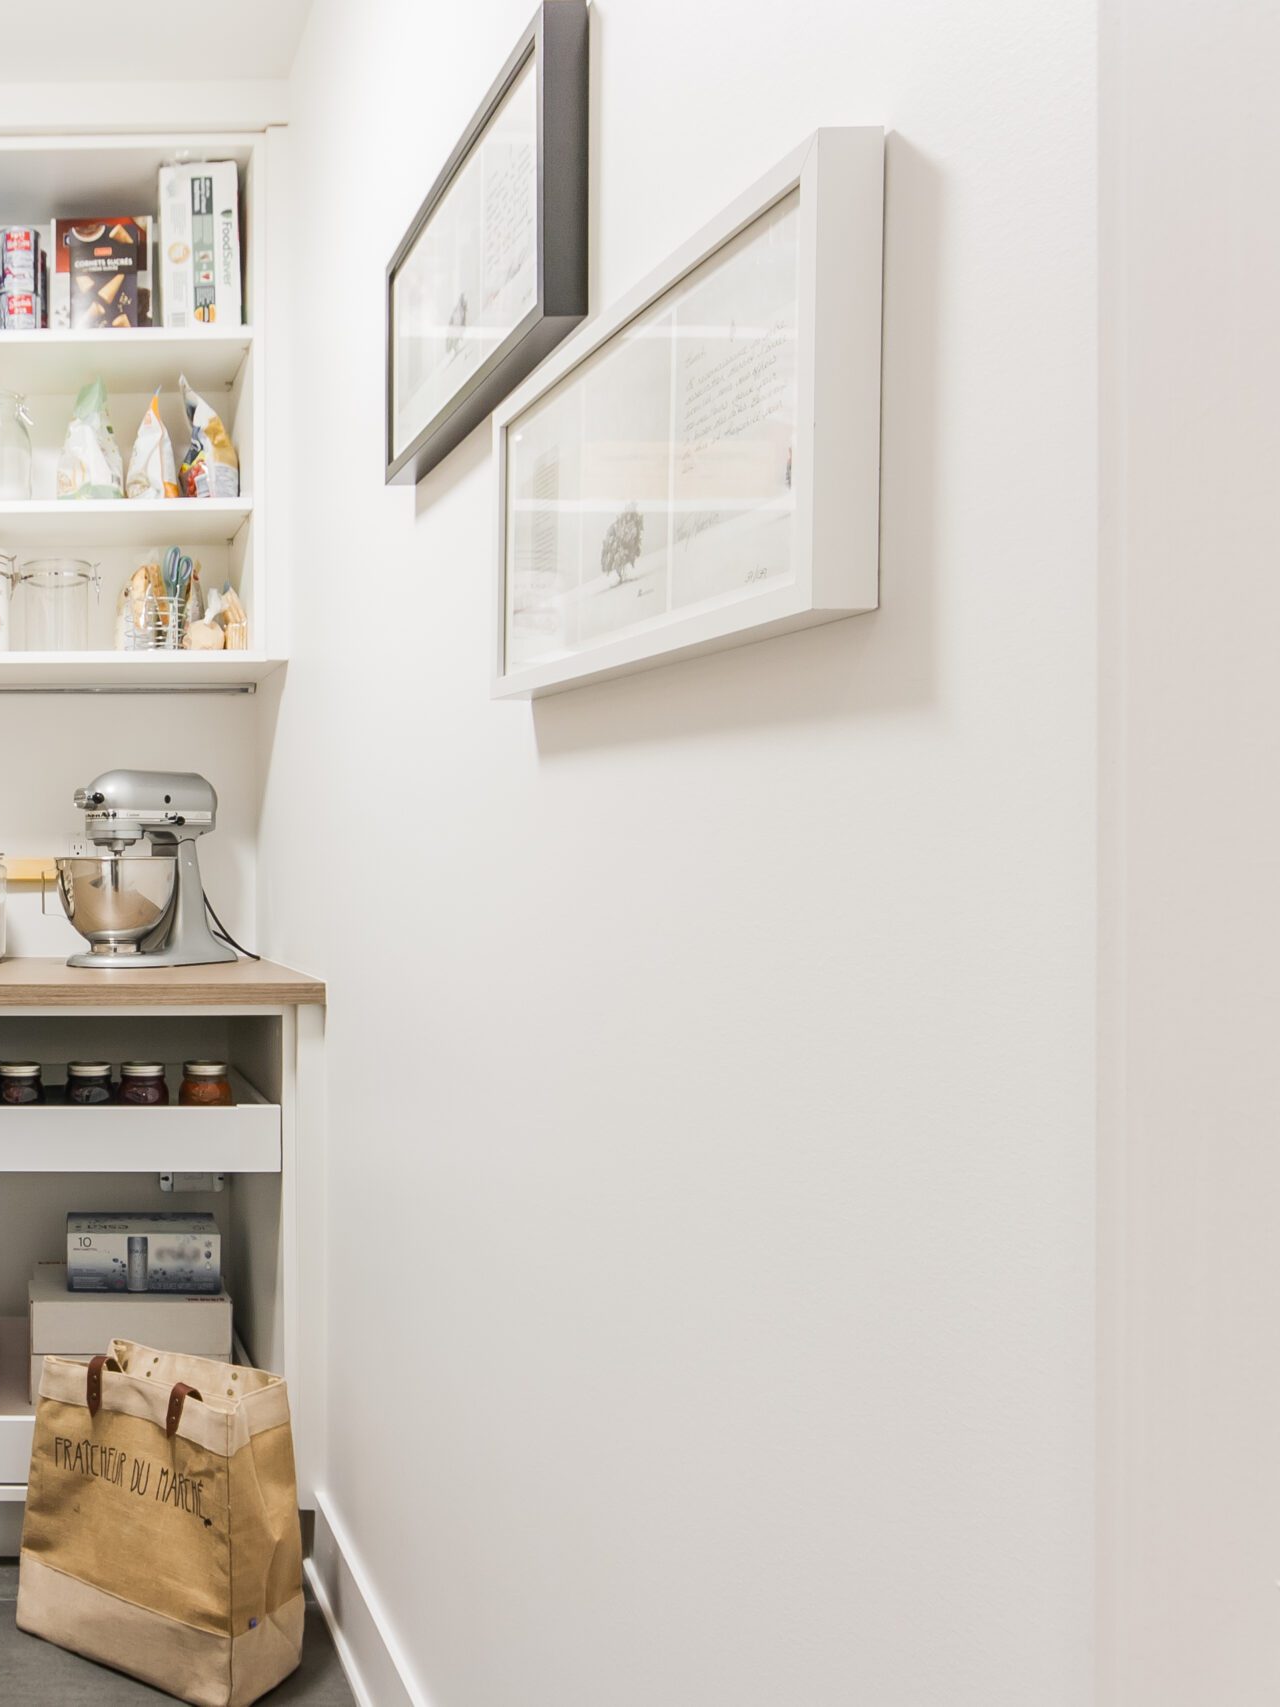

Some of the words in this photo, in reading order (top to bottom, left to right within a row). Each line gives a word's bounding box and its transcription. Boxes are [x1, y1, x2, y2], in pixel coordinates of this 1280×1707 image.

[222, 221, 233, 287] FoodSaver
[78, 1236, 92, 1248] 10
[54, 1436, 127, 1489] FRAÎCHEUR
[130, 1458, 151, 1496] DU
[155, 1466, 206, 1520] MARCHÉ
